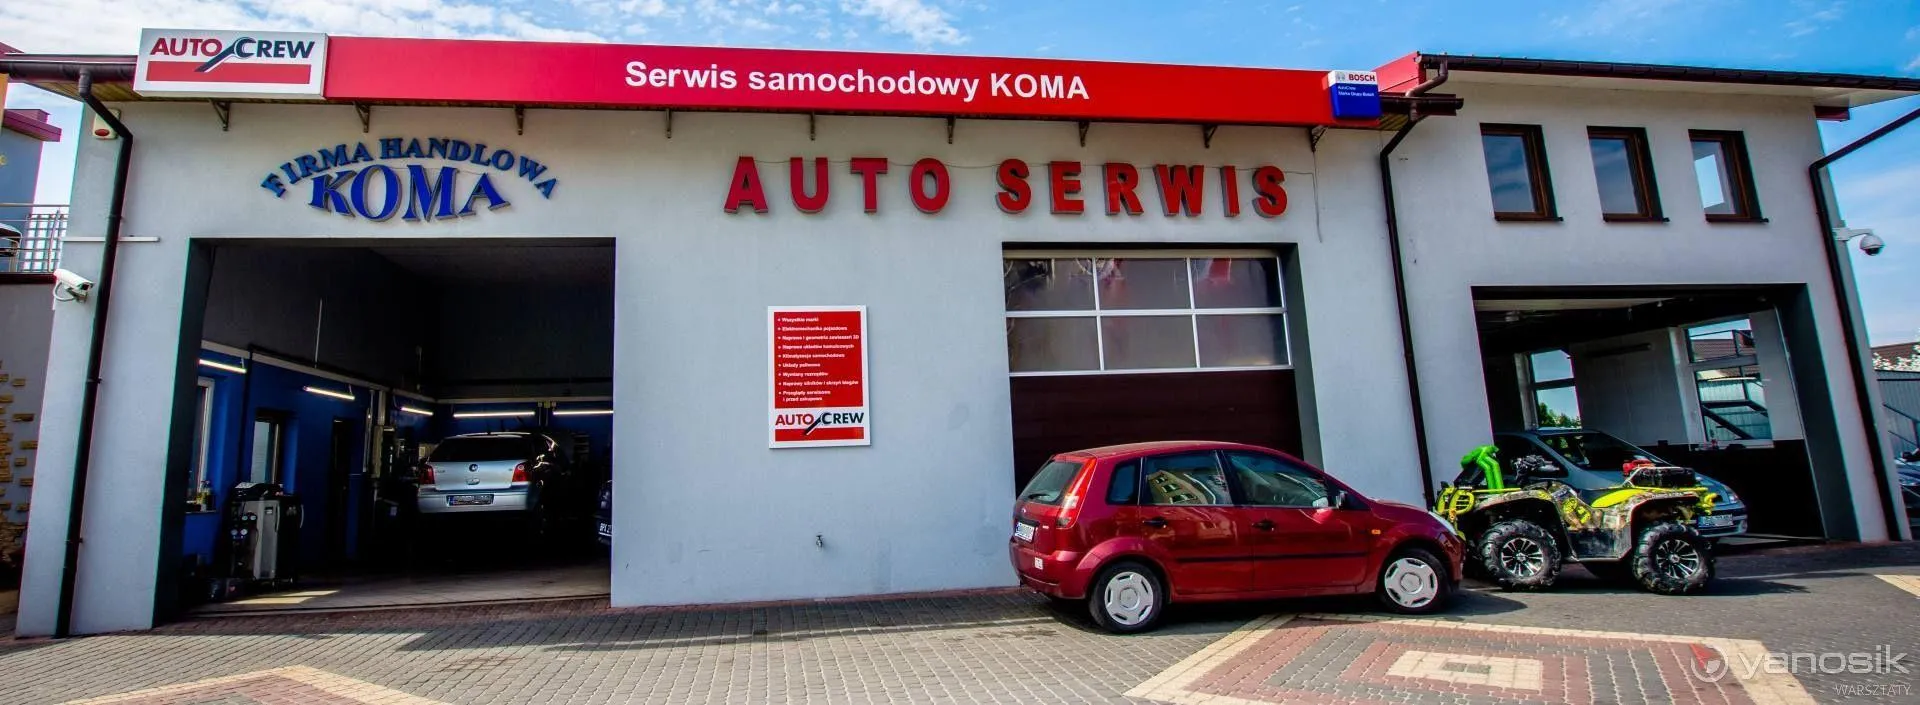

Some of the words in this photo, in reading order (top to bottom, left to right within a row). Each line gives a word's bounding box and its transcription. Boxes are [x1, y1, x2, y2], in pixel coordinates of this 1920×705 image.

[150, 37, 223, 57] AUTO
[625, 61, 737, 89] Serwis
[748, 68, 979, 103] samochodowy
[991, 73, 1090, 100] KOMA
[261, 141, 374, 199] FIRMA
[379, 137, 557, 200] HANDLOWA
[308, 164, 511, 222] KOMA
[724, 156, 951, 214] AUTO
[996, 158, 1288, 217] SERWIS
[775, 413, 814, 425] AUTO
[822, 412, 864, 424] CREW
